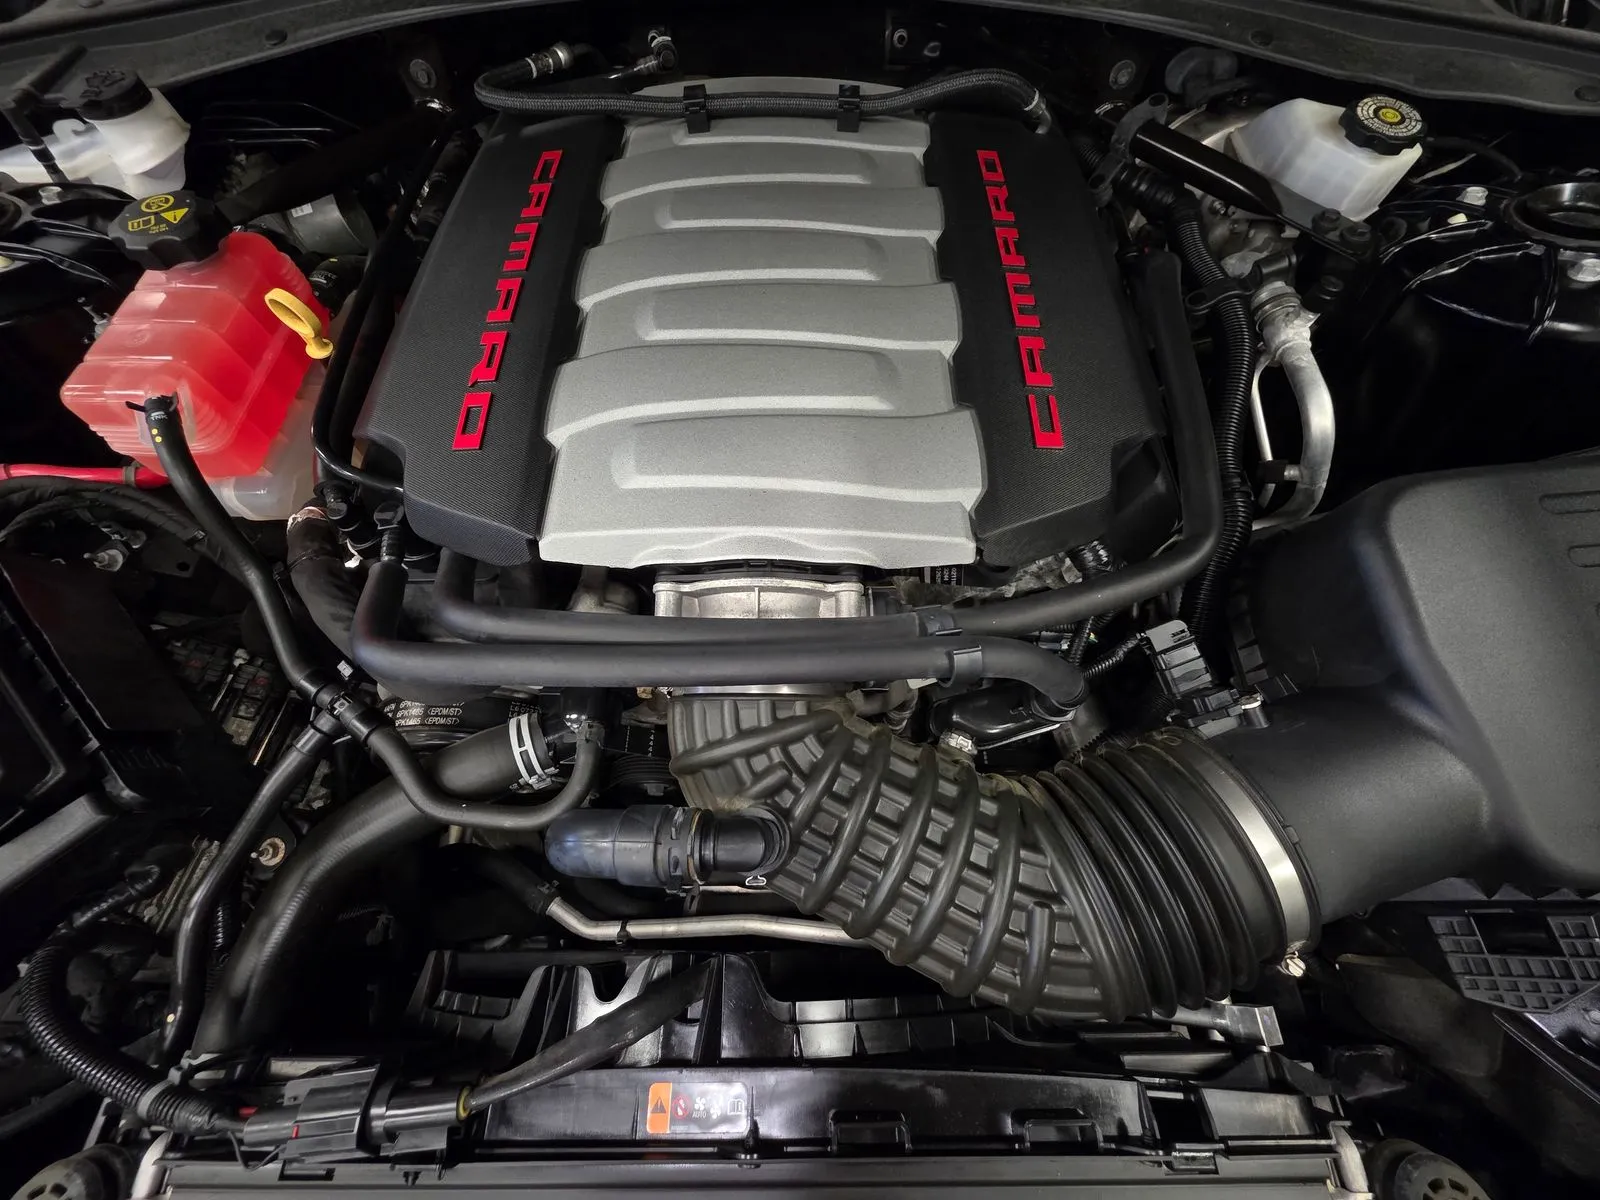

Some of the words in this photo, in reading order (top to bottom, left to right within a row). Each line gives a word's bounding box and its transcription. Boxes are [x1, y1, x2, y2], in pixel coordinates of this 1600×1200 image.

[451, 150, 562, 450] CAMARO
[977, 150, 1066, 449] CAMARO
[691, 1111, 707, 1119] AUTO
